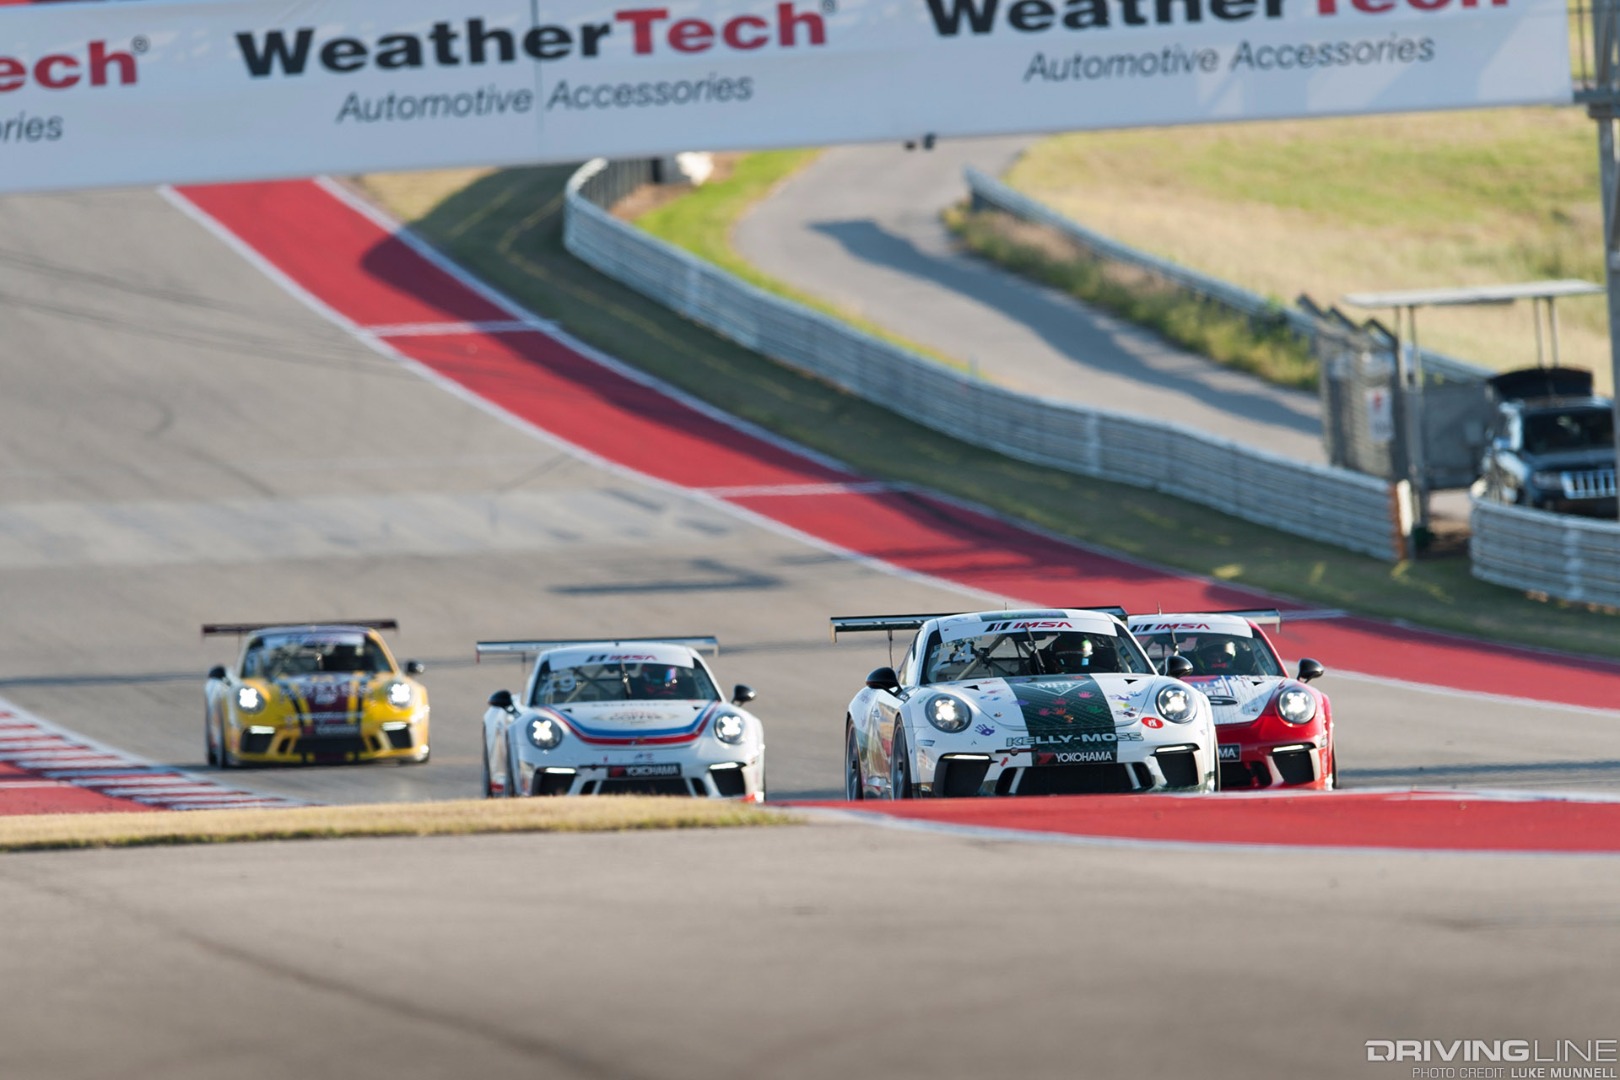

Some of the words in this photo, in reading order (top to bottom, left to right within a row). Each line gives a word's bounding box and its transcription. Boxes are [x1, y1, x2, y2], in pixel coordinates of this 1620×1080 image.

[1023, 43, 1219, 83] Automotive
[1230, 32, 1436, 71] Accessories
[336, 84, 534, 124] Automotive
[546, 73, 753, 111] Accessories
[1013, 621, 1073, 630] IMSA
[1155, 623, 1211, 631] IMSA
[1006, 732, 1144, 747] KELLY-MOSS
[1055, 751, 1113, 763] YOKOHAMA
